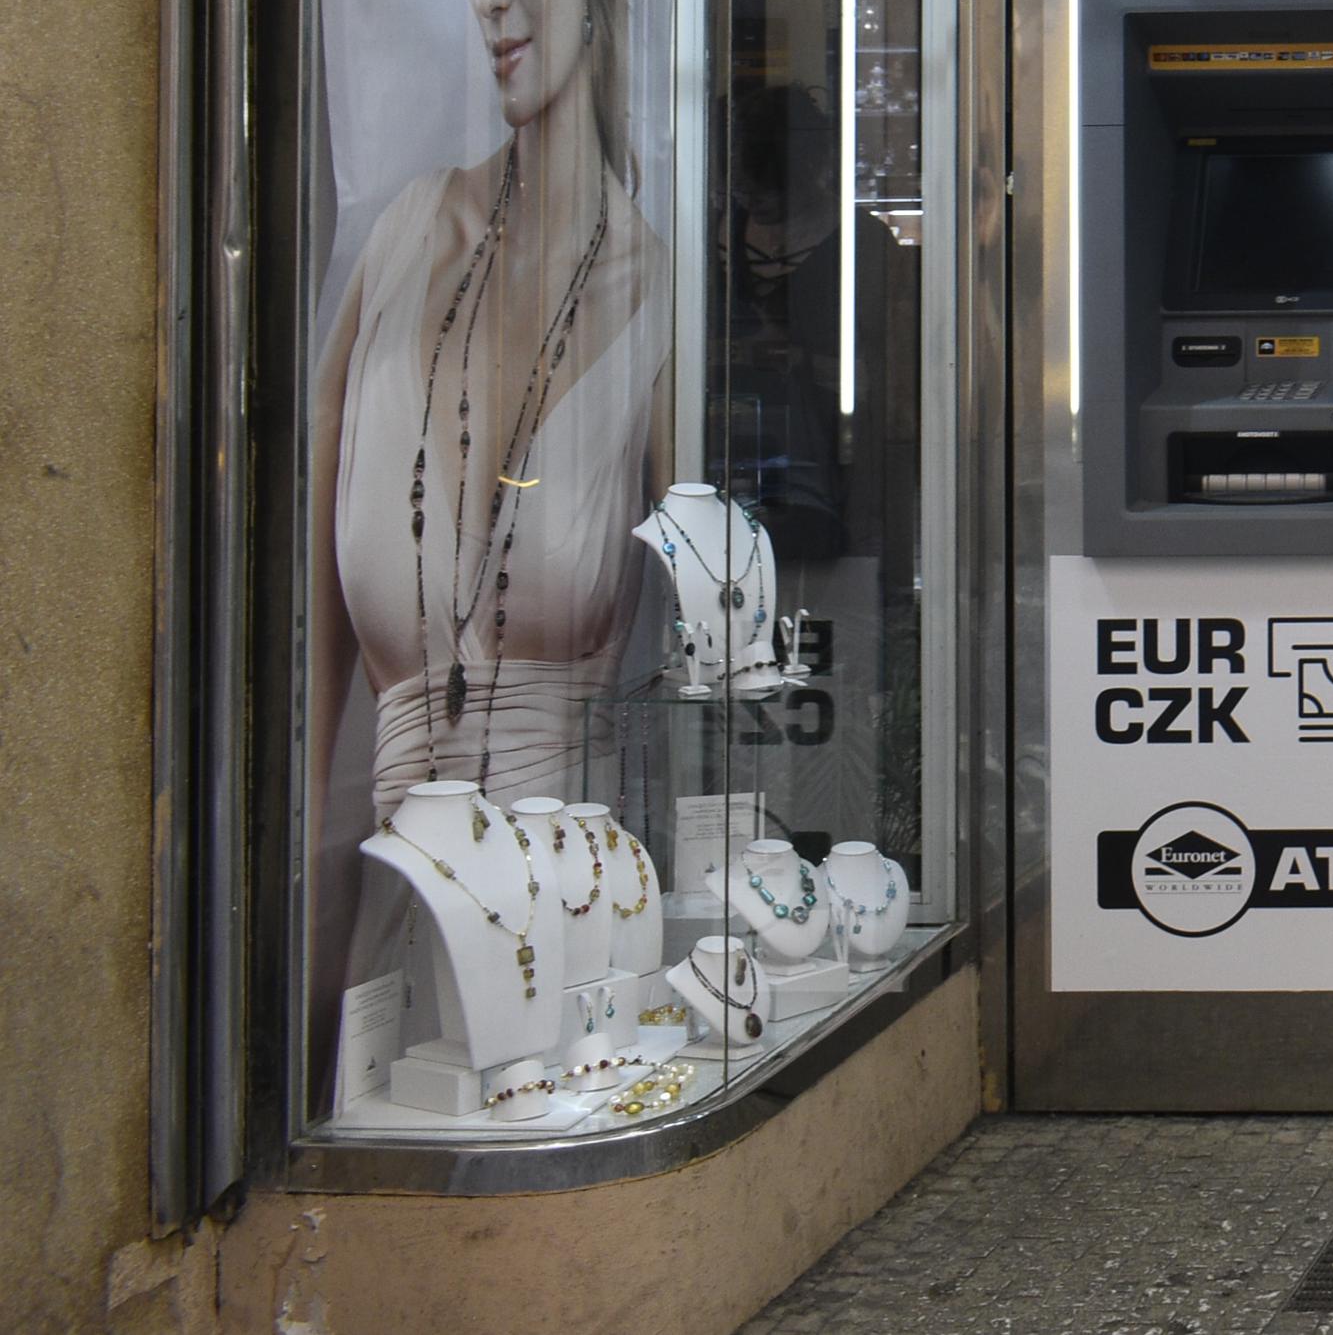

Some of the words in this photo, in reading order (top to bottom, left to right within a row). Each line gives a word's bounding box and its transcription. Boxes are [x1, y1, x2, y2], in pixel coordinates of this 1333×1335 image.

[1096, 618, 1246, 675] EUR
[1095, 687, 1250, 744] CZK
[1161, 846, 1226, 864] Euronet
[1145, 883, 1243, 891] WORLDWIDE
